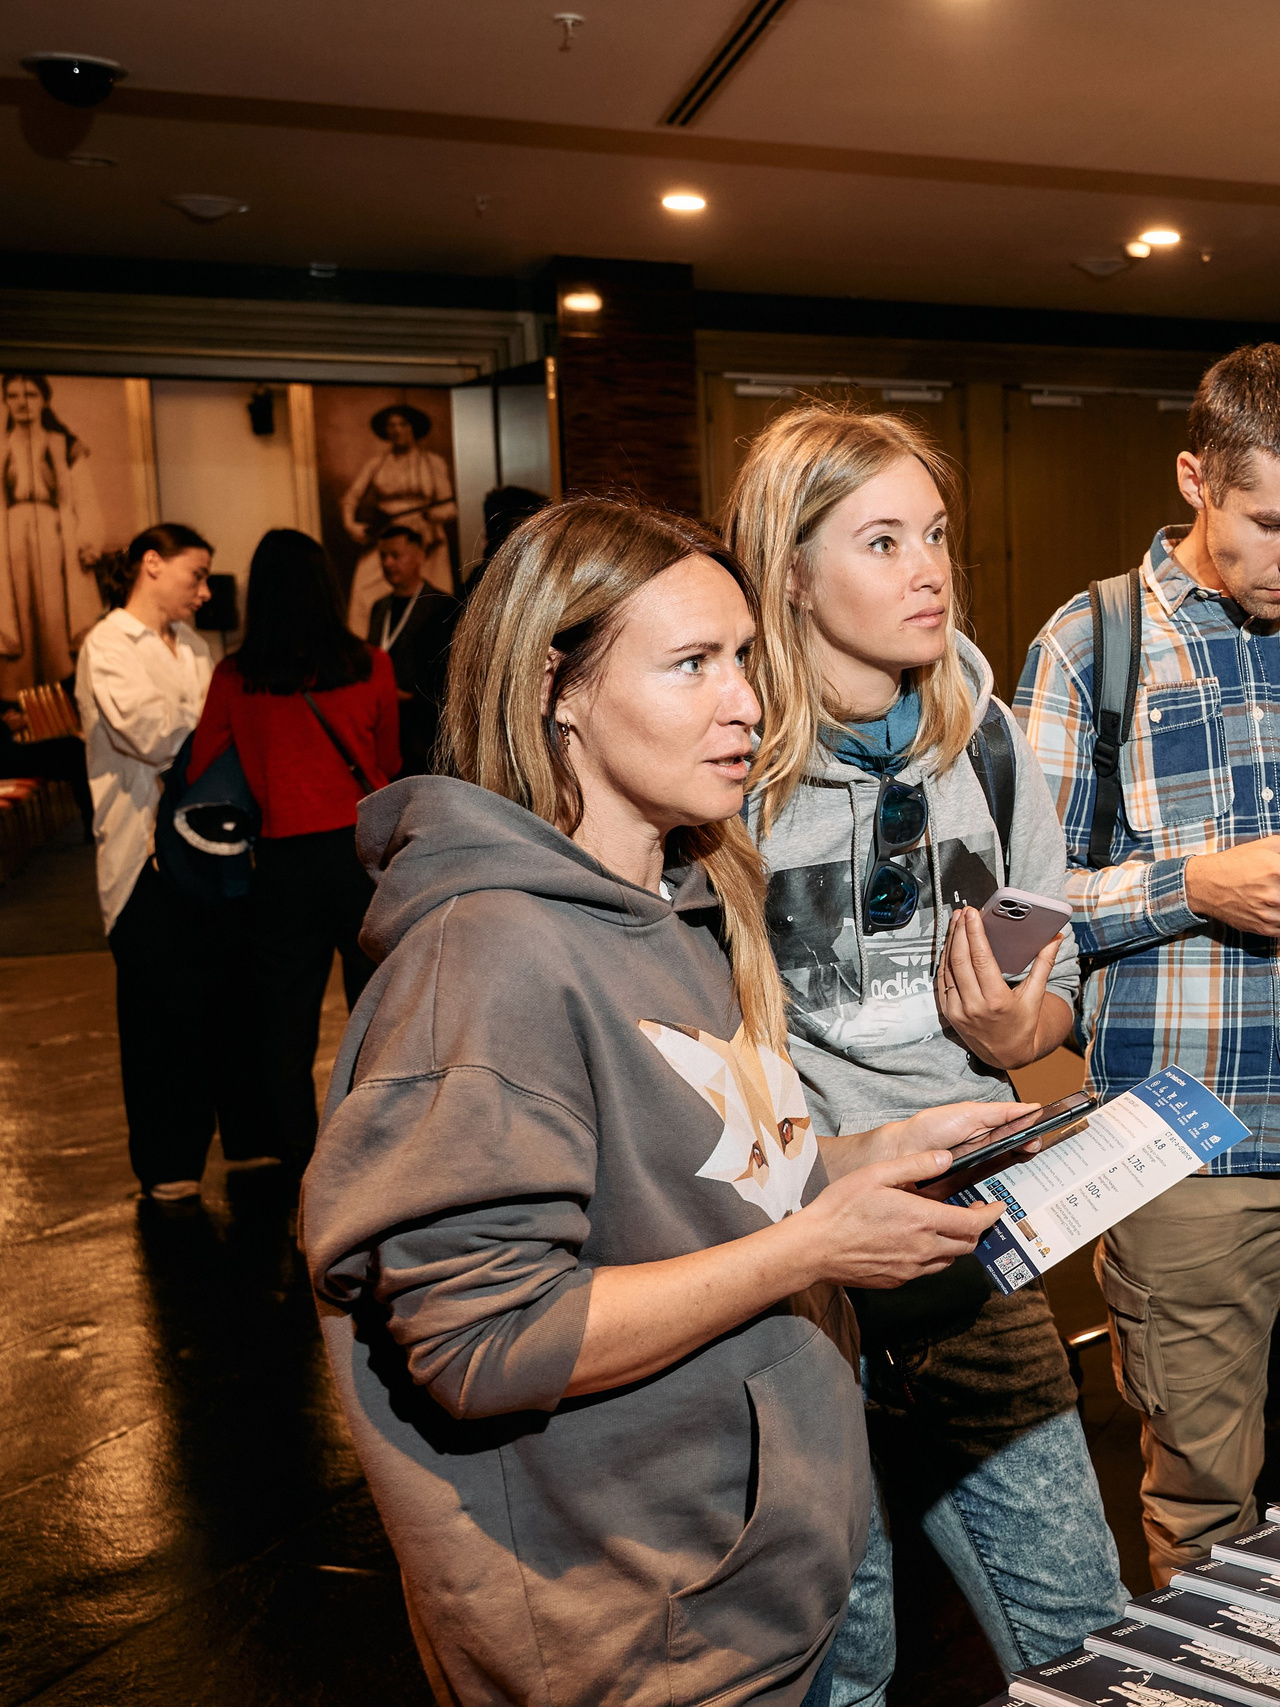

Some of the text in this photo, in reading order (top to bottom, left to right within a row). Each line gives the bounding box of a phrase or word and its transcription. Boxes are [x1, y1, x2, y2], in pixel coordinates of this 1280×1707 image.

[871, 971, 933, 999] adid
[1154, 1139, 1166, 1150] 4.8
[1170, 1137, 1192, 1160] at-a-Glance
[1085, 1182, 1100, 1198] 100+
[1066, 1194, 1078, 1206] 10+
[1039, 1652, 1100, 1677] MERTIMES
